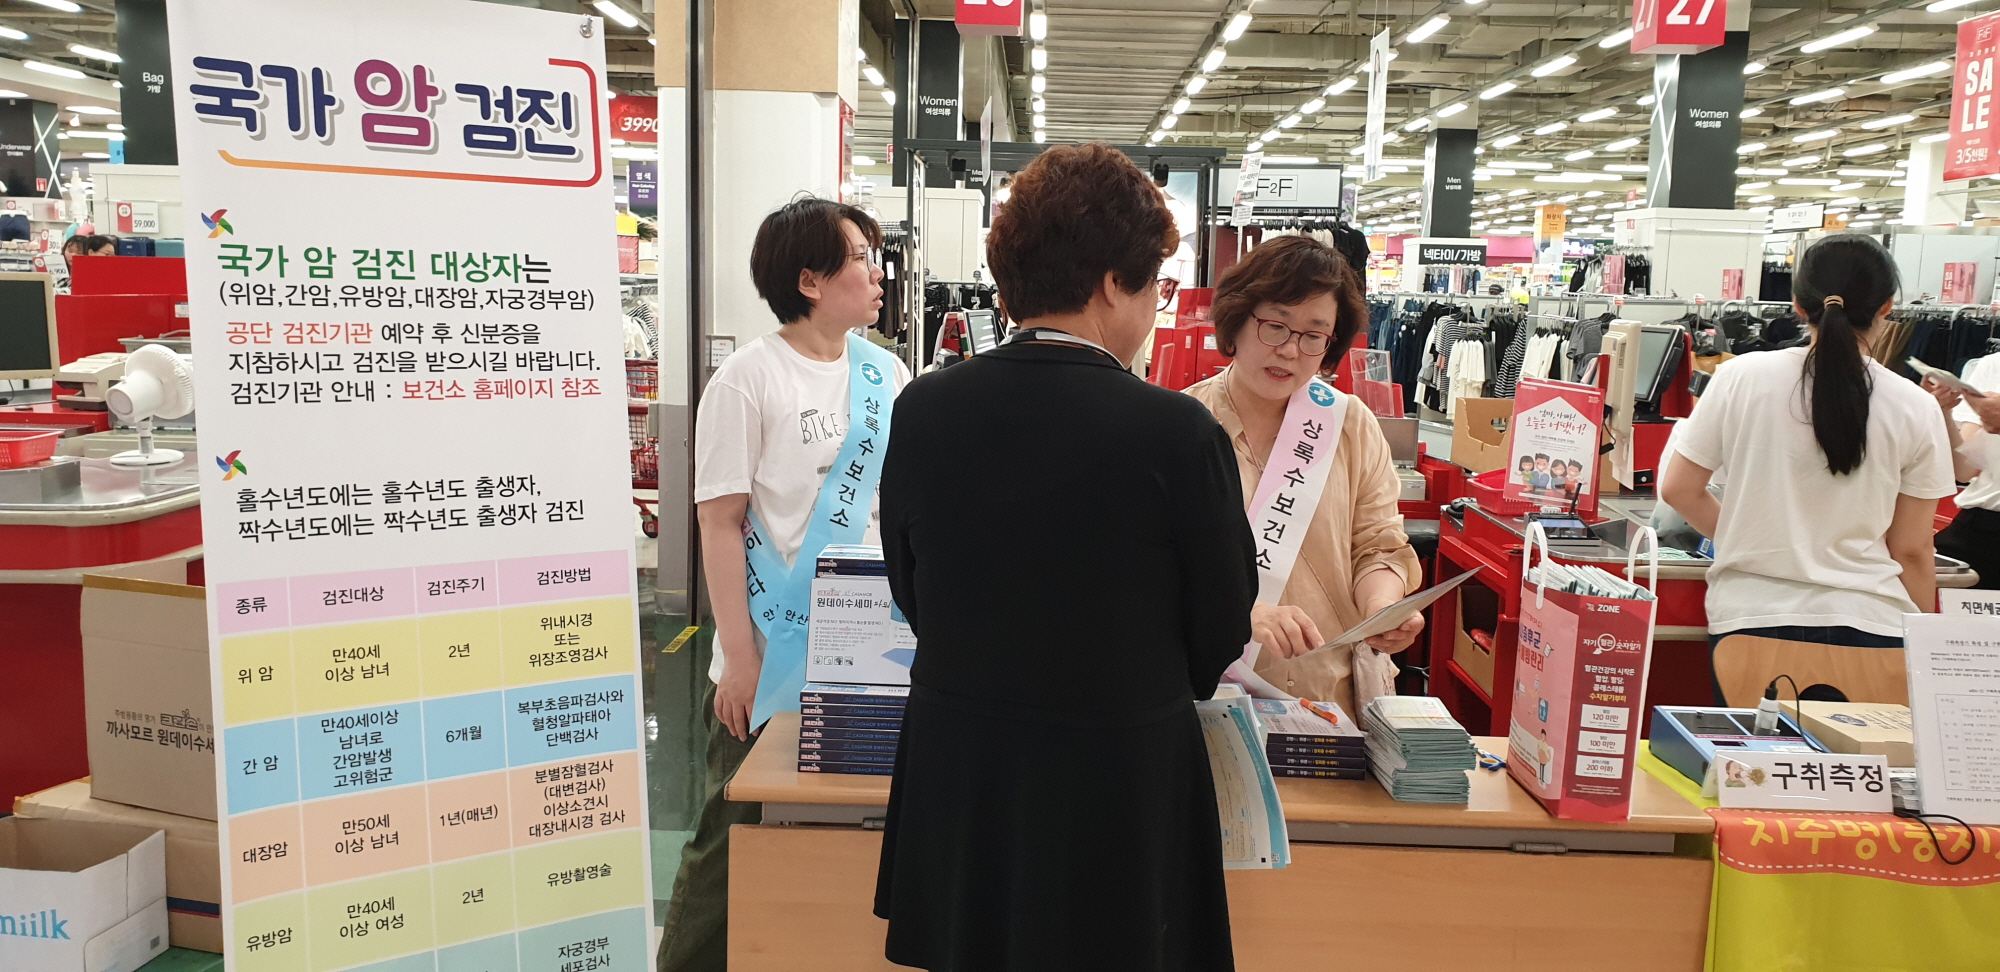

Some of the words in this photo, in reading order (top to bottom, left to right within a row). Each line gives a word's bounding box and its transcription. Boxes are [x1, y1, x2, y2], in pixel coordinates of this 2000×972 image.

[1666, 0, 1713, 25] 27
[143, 73, 163, 84] Bag
[147, 85, 161, 93] 가방
[190, 57, 335, 138] 국가
[354, 59, 439, 147] 암
[455, 83, 576, 155] 검진
[919, 95, 957, 107] Women
[925, 107, 951, 116] 여성의류
[1690, 109, 1729, 119] Women
[1695, 120, 1722, 129] 여성의류
[1256, 179, 1293, 197] F2F
[1447, 176, 1461, 184] Men
[134, 220, 156, 229] 59,000
[218, 244, 289, 278] 국가
[304, 247, 337, 278] 암
[352, 249, 415, 280] 검진
[431, 251, 551, 283] 대상자는
[1423, 248, 1481, 263] 넥타이/가방
[226, 322, 273, 344] 공단
[283, 322, 373, 344] 검진기관
[382, 323, 424, 344] 예약
[432, 323, 452, 344] 후
[461, 324, 541, 344] 신분증을
[229, 352, 344, 374] 지참하시고
[354, 351, 417, 373] 검진을
[426, 351, 507, 372] 받으시길
[516, 351, 600, 371] 바랍니다.
[231, 381, 322, 404] 검진기관
[332, 381, 374, 402] 안내
[403, 380, 466, 400] 보건소
[473, 378, 553, 399] 홈페이지
[562, 378, 601, 398] 참조
[1526, 417, 1546, 429] 오늘은
[829, 395, 881, 528] 상록수보건소
[237, 484, 373, 512] 홀수년도에는
[382, 479, 467, 504] 홀수년도
[475, 475, 540, 498] 출생자,
[1256, 419, 1324, 571] 상록수보건소
[239, 511, 374, 543] 짝수년도에는
[384, 508, 468, 533] 짝수년도
[477, 503, 537, 527] 출생자
[546, 500, 584, 522] 검진
[428, 577, 484, 596] 검진주기
[537, 568, 590, 585] 검진방법
[236, 597, 267, 614] 종류
[323, 586, 384, 605] 검진대상
[817, 598, 872, 608] 원데이수세미
[1597, 604, 1620, 613] ZONE
[541, 613, 592, 630] 위내시경
[554, 633, 580, 645] 또는
[333, 644, 380, 666] 만40세
[449, 643, 470, 657] 2년
[529, 647, 608, 667] 위장조영검사
[238, 669, 251, 684] 위
[259, 666, 273, 681] 암
[326, 666, 354, 682] 이상
[361, 662, 389, 678] 남녀
[518, 690, 624, 717] 복부초음파검사와
[319, 708, 398, 734] 만40세이상
[530, 707, 611, 733] 혈청알파태아
[1592, 713, 1603, 721] 120
[107, 721, 154, 742] 까사모르
[340, 732, 384, 751] 남녀로
[446, 726, 481, 742] 6개월
[547, 726, 598, 747] 단백검사
[243, 759, 257, 775] 간
[264, 755, 278, 771] 암
[334, 746, 391, 771] 간암발생
[334, 766, 392, 787] 고위험군
[535, 759, 613, 785] 분별잠혈검사
[1771, 762, 1884, 793] 구취측정
[542, 777, 607, 802] (대변검사)
[440, 805, 498, 826] 1년(매년)
[544, 794, 610, 818] 이상소견시
[343, 814, 389, 836] 만50세
[529, 814, 593, 837] 대장내시경
[600, 810, 625, 825] 검사
[243, 842, 287, 862] 대장암
[335, 838, 364, 854] 이상
[371, 832, 398, 849] 남녀
[547, 864, 611, 887] 유방촬영술
[463, 888, 483, 904] 2년
[348, 897, 397, 920] 만40세
[340, 921, 369, 938] 이상
[376, 914, 403, 930] 여성
[247, 928, 292, 952] 유방암
[559, 937, 610, 960] 자궁경부
[559, 952, 610, 972] 세포검사
